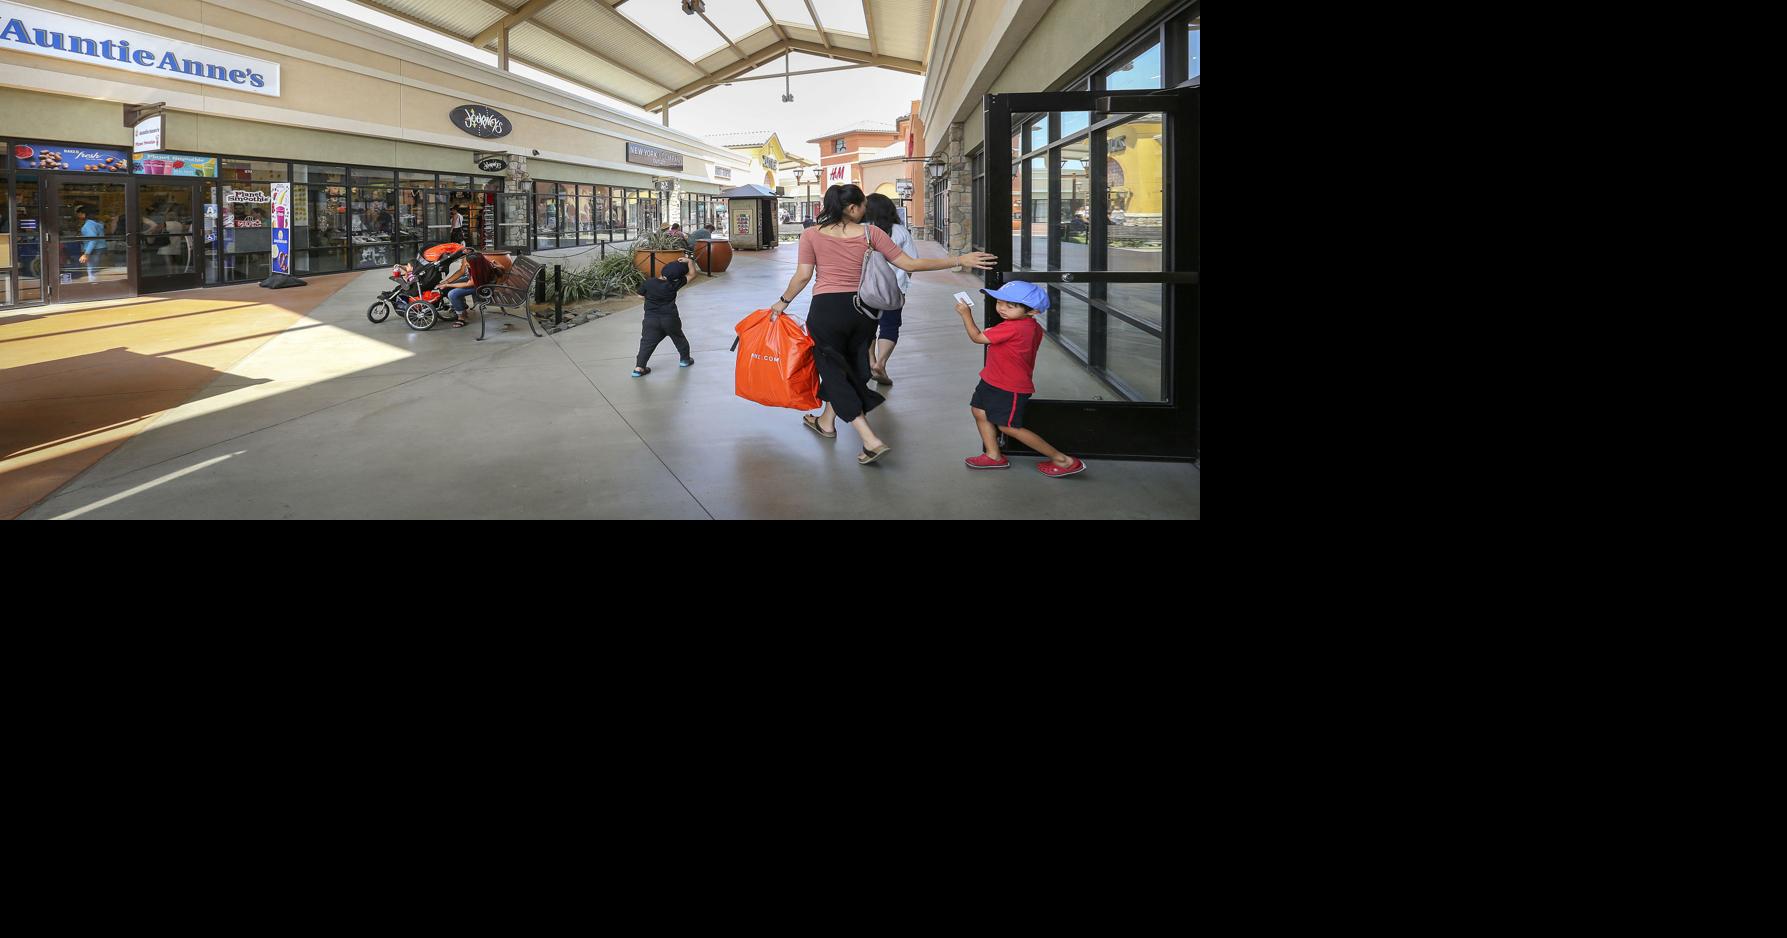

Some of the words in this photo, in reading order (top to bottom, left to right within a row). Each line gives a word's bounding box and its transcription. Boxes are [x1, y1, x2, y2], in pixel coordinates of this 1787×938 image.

[0, 18, 156, 67] Auntie
[157, 51, 265, 88] Anne's
[75, 151, 102, 160] fresh
[830, 166, 845, 180] H&M
